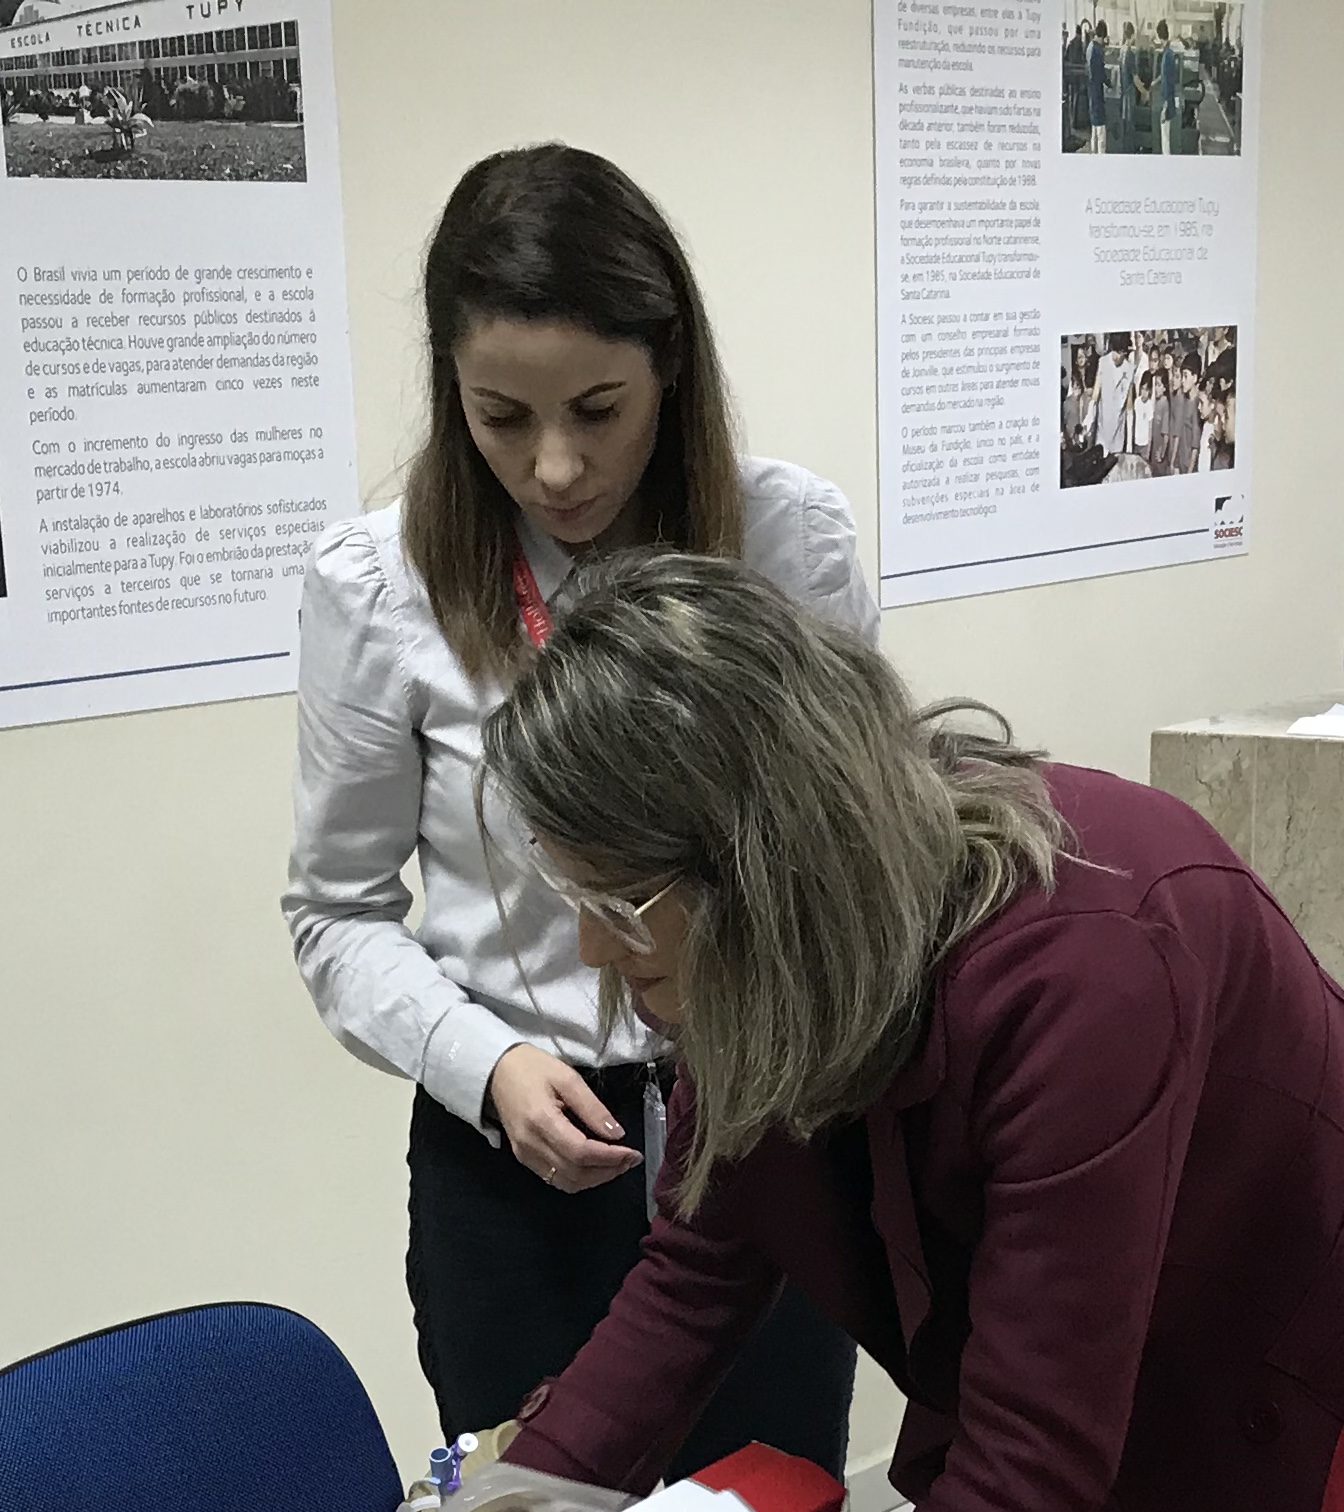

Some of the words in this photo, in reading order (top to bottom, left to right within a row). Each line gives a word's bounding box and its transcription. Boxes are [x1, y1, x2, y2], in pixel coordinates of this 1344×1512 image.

[9, 31, 52, 49] ESCOLA
[76, 15, 142, 38] TÉCNICA
[185, 0, 246, 20] TUPY
[33, 266, 65, 281] Brasil
[70, 265, 97, 281] vivia
[126, 265, 170, 284] período
[193, 265, 232, 285] grande
[236, 266, 301, 279] crescimento
[18, 289, 91, 305] necessidade
[121, 288, 175, 307] formação
[281, 286, 314, 301] escola
[21, 317, 63, 333] passou
[86, 312, 129, 327] receber
[138, 314, 186, 326] recursos
[193, 309, 238, 328] públicos
[245, 308, 302, 323] destinados
[23, 337, 80, 356] educação
[128, 335, 164, 349] Houve
[166, 332, 204, 352] grande
[206, 332, 260, 350] ampliação
[276, 331, 317, 345] número
[41, 363, 80, 375] cursos
[145, 360, 170, 375] para
[171, 354, 213, 370] atender
[215, 352, 270, 369] demandas
[286, 352, 318, 370] região
[67, 381, 127, 397] matrículas
[137, 380, 206, 394] aumentaram
[215, 379, 244, 390] cinco
[252, 378, 282, 389] vezes
[290, 375, 319, 387] neste
[32, 440, 60, 455] Com
[83, 436, 148, 452] incremento
[177, 433, 223, 450] ingresso
[229, 429, 248, 443] das
[255, 426, 302, 441] mulheres
[33, 460, 85, 478] mercado
[162, 453, 197, 469] escola
[198, 452, 225, 467] abriu
[226, 453, 257, 468] vagas
[258, 451, 282, 466] para
[282, 449, 316, 464] moças
[36, 487, 67, 504] partir
[52, 515, 109, 533] instalação
[132, 508, 185, 528] aparelhos
[199, 503, 262, 519] laboratórios
[266, 497, 327, 514] sofisticados
[40, 538, 99, 555] viabilizou
[126, 530, 185, 548] realização
[219, 526, 266, 541] serviços
[275, 519, 325, 537] especiais
[42, 560, 111, 577] inicialmente
[113, 559, 138, 575] para
[178, 551, 195, 565] Foi
[205, 546, 249, 562] embrião
[45, 585, 94, 601] serviços
[120, 578, 170, 593] terceiros
[179, 575, 200, 590] que
[230, 568, 273, 582] tornaria
[282, 564, 305, 577] uma
[47, 604, 117, 625] importantes
[118, 600, 154, 614] fontes
[171, 595, 217, 609] recursos
